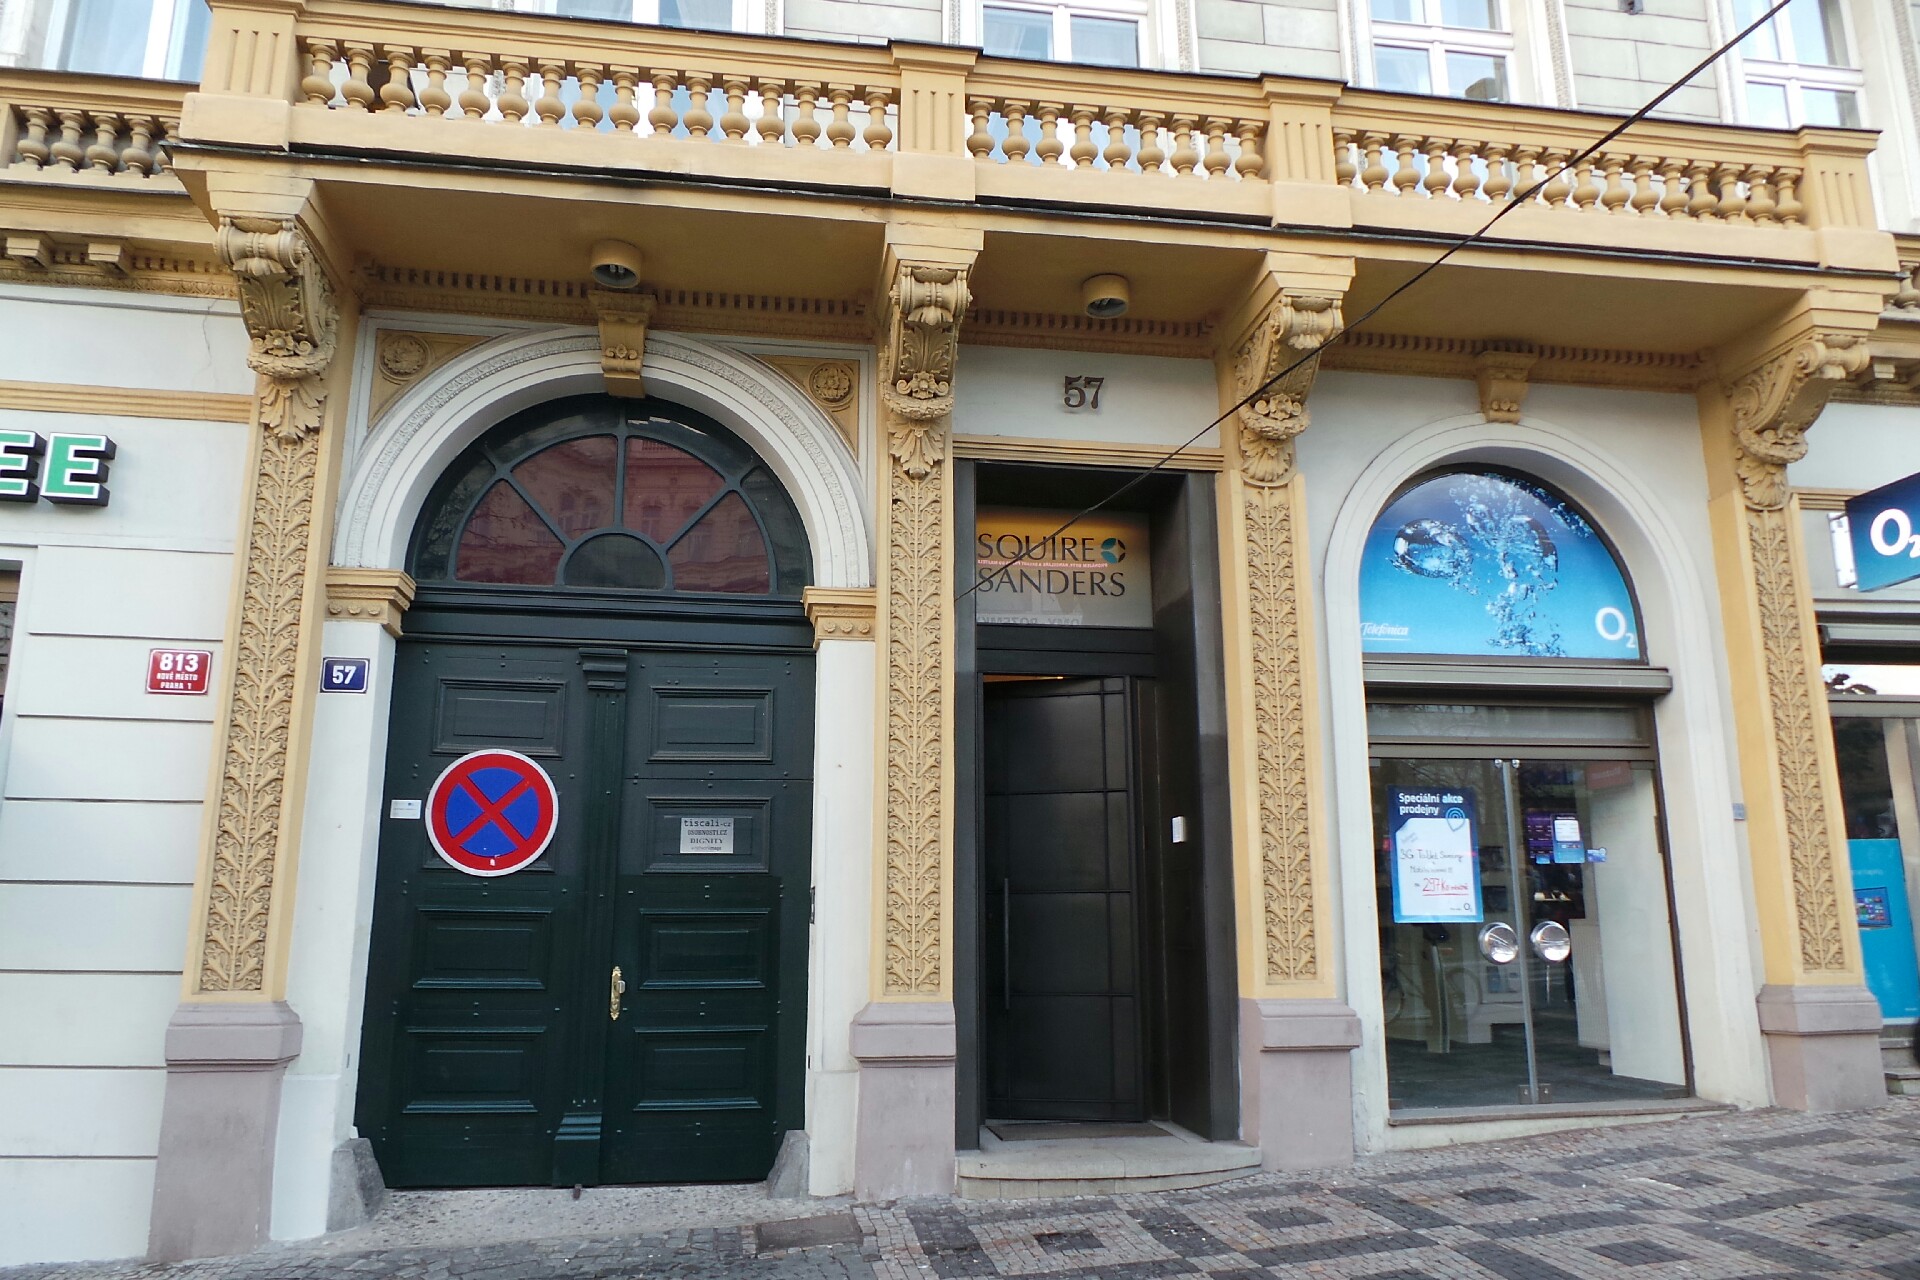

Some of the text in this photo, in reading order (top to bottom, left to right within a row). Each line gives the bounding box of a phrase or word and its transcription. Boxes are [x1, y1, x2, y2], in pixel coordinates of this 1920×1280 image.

[1063, 375, 1105, 410] 57
[977, 533, 1096, 563] SQUIRE
[977, 567, 1126, 597] SANDERS
[1595, 606, 1636, 648] O2
[159, 653, 199, 672] 813
[332, 665, 357, 685] 57
[187, 682, 192, 690] 1
[1398, 793, 1464, 804] Speciální akce
[1399, 805, 1440, 815] prodejny
